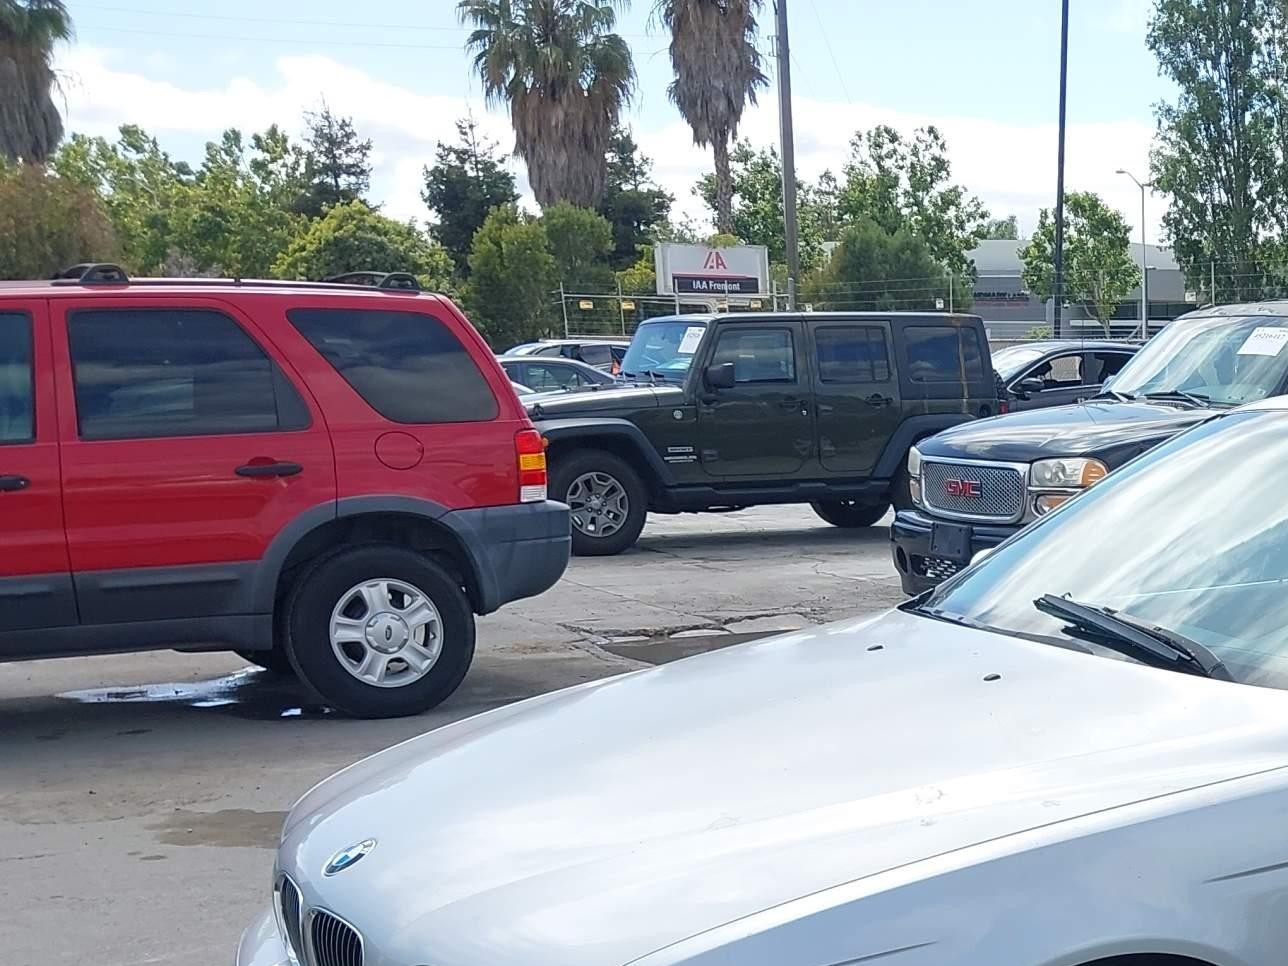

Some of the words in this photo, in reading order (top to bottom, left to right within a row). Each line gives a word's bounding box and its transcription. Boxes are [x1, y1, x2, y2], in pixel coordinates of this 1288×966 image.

[692, 281, 708, 290] IAA
[709, 281, 740, 291] Fremont
[946, 479, 981, 497] GMC
